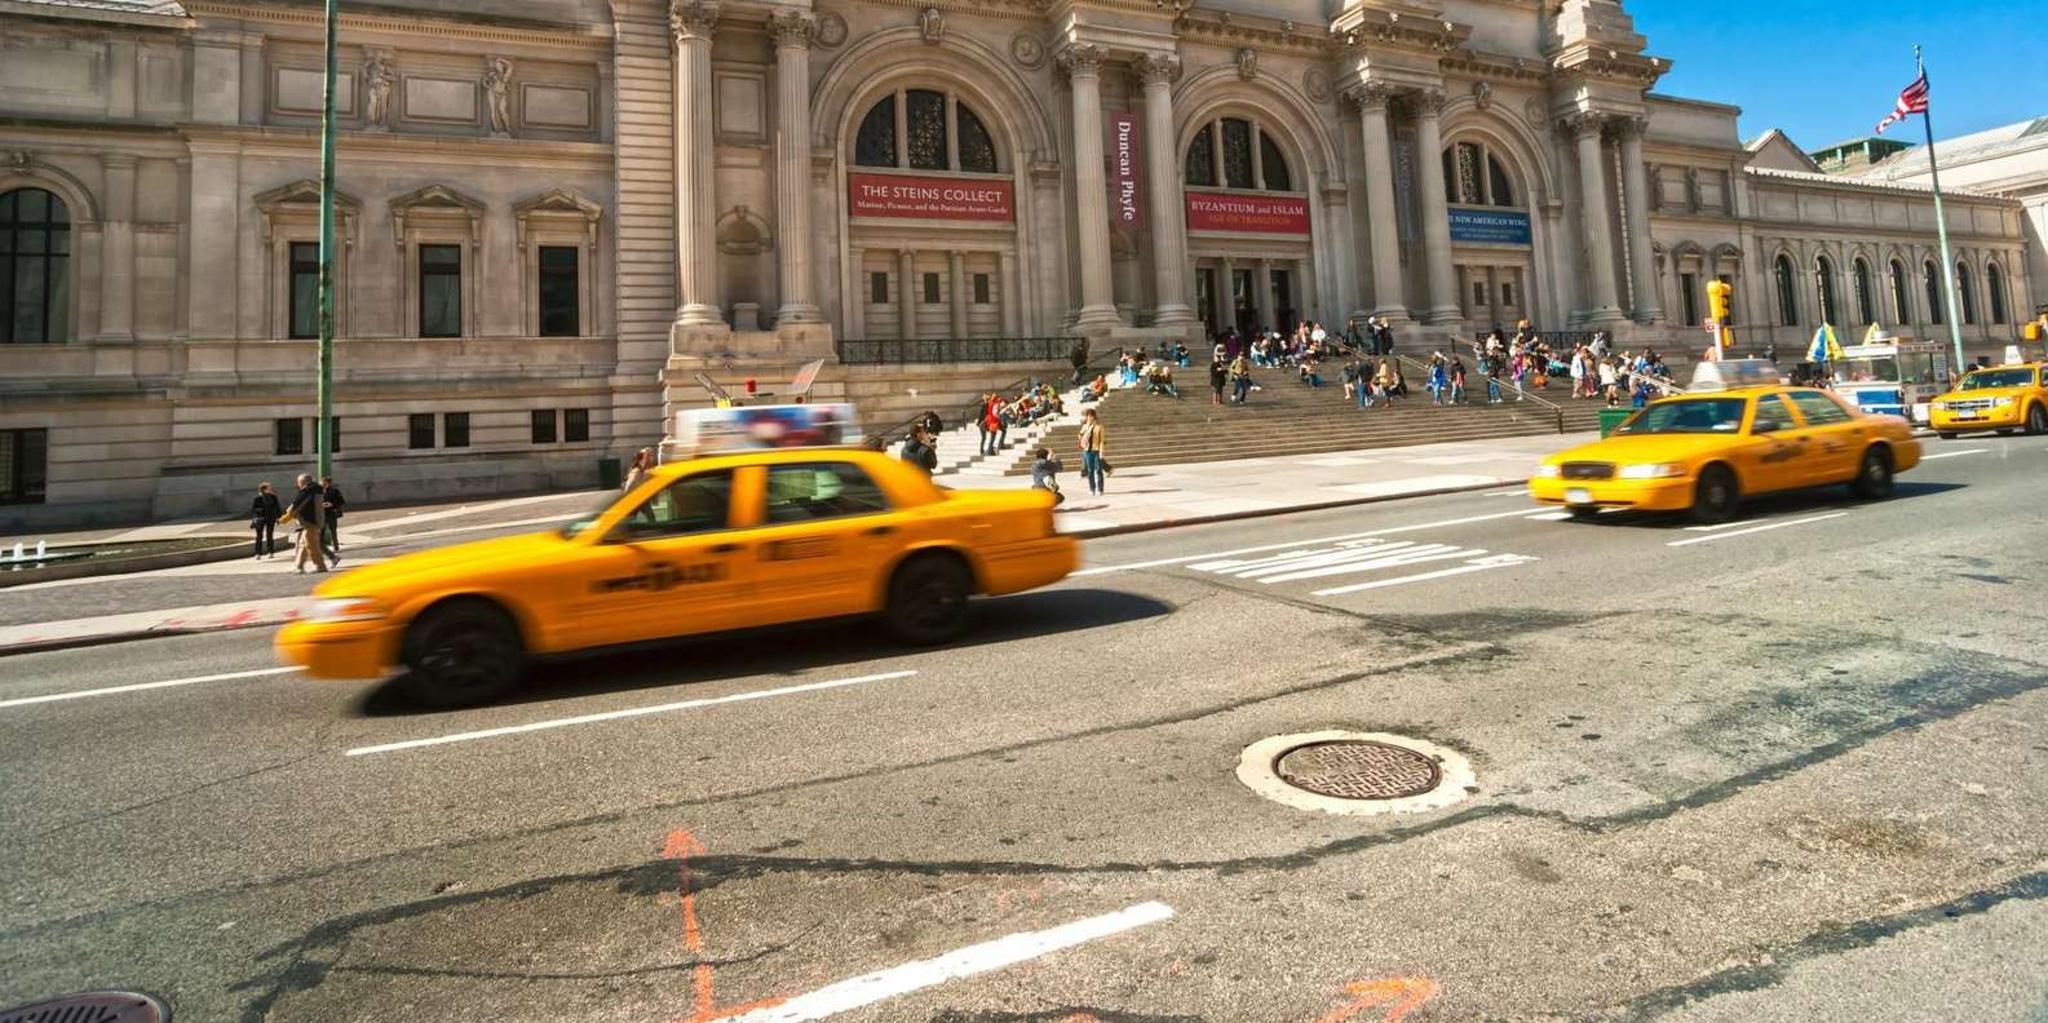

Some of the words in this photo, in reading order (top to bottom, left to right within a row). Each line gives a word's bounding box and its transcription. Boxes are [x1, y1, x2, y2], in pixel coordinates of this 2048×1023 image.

[1118, 121, 1131, 175] Duncan
[862, 185, 888, 198] THE
[893, 186, 939, 200] STEINS
[943, 188, 1003, 203] COLLECT
[1119, 181, 1136, 221] Phyfe
[914, 202, 928, 211] and
[929, 203, 940, 211] the
[1191, 201, 1254, 214] BYZANTIUM
[1257, 206, 1271, 214] and
[1273, 206, 1304, 216] ISLAM
[1455, 215, 1472, 224] NEW
[1472, 216, 1507, 226] AMERICAN
